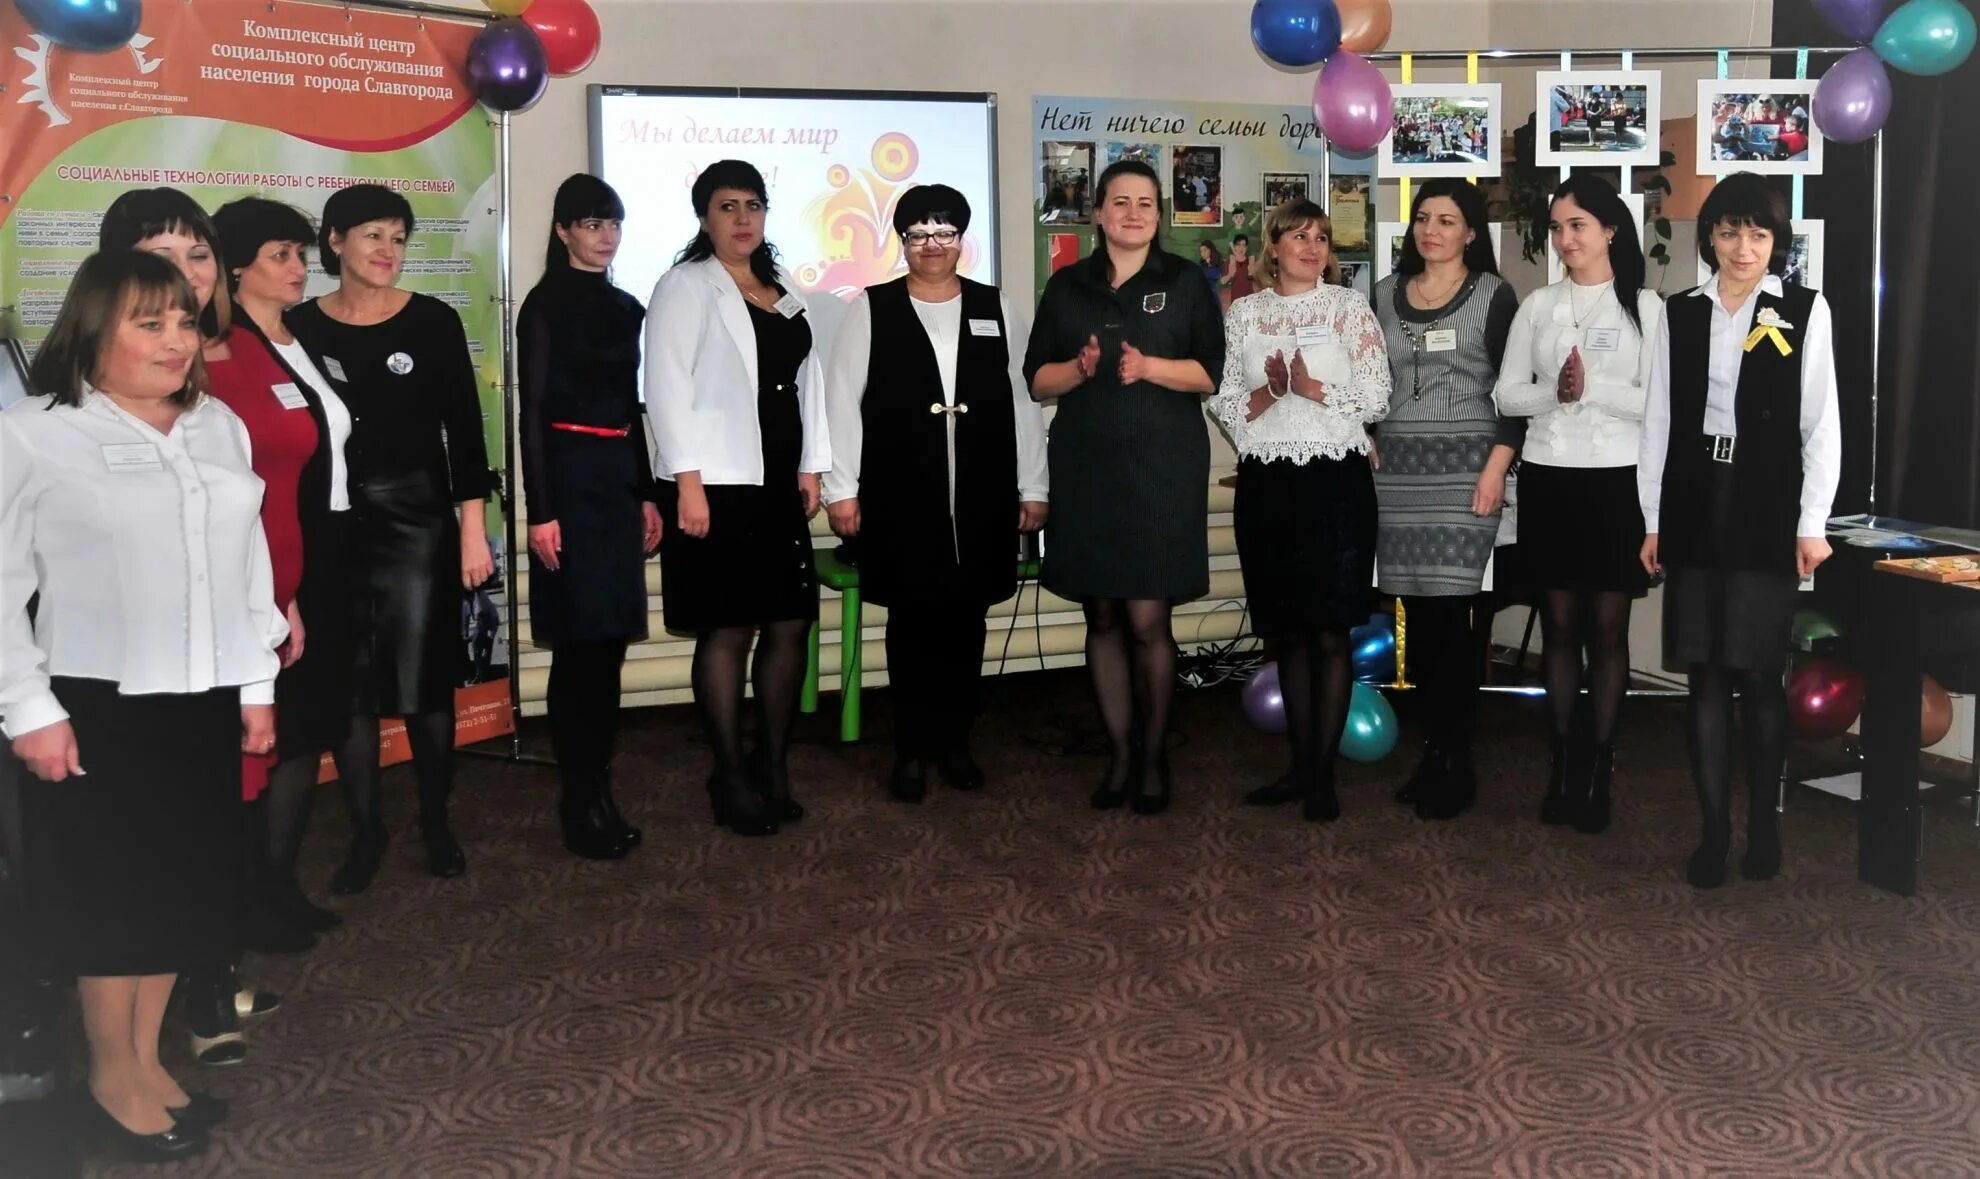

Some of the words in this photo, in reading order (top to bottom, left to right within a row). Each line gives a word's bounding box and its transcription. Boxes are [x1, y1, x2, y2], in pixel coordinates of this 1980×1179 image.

[243, 19, 364, 49] Комплексный
[368, 37, 416, 57] центр
[211, 43, 325, 66] социального
[329, 53, 444, 78] обслуживания
[69, 72, 132, 86] Комплексный
[133, 80, 159, 89] центр
[69, 87, 126, 99] социального
[127, 90, 189, 103] обслуживания
[200, 65, 295, 86] населения
[304, 74, 360, 93] города
[364, 76, 453, 101] Славгорода
[71, 100, 117, 110] населения
[619, 118, 673, 144] Мы
[683, 115, 776, 145] делаем
[782, 127, 839, 154] мир
[1041, 106, 1093, 132] Нет
[1106, 115, 1186, 134] ничего
[1198, 119, 1267, 137] семьи
[57, 165, 160, 183] СОЦИАЛЬНЫЕ
[164, 169, 250, 186] ТЕХНОЛОГИИ
[253, 174, 302, 188] РАБОТЫ
[305, 176, 315, 188] С
[318, 176, 377, 190] РЕБЕНКОМ
[391, 179, 411, 191] ЕГО
[414, 179, 455, 193] СЕМЬЕЙ
